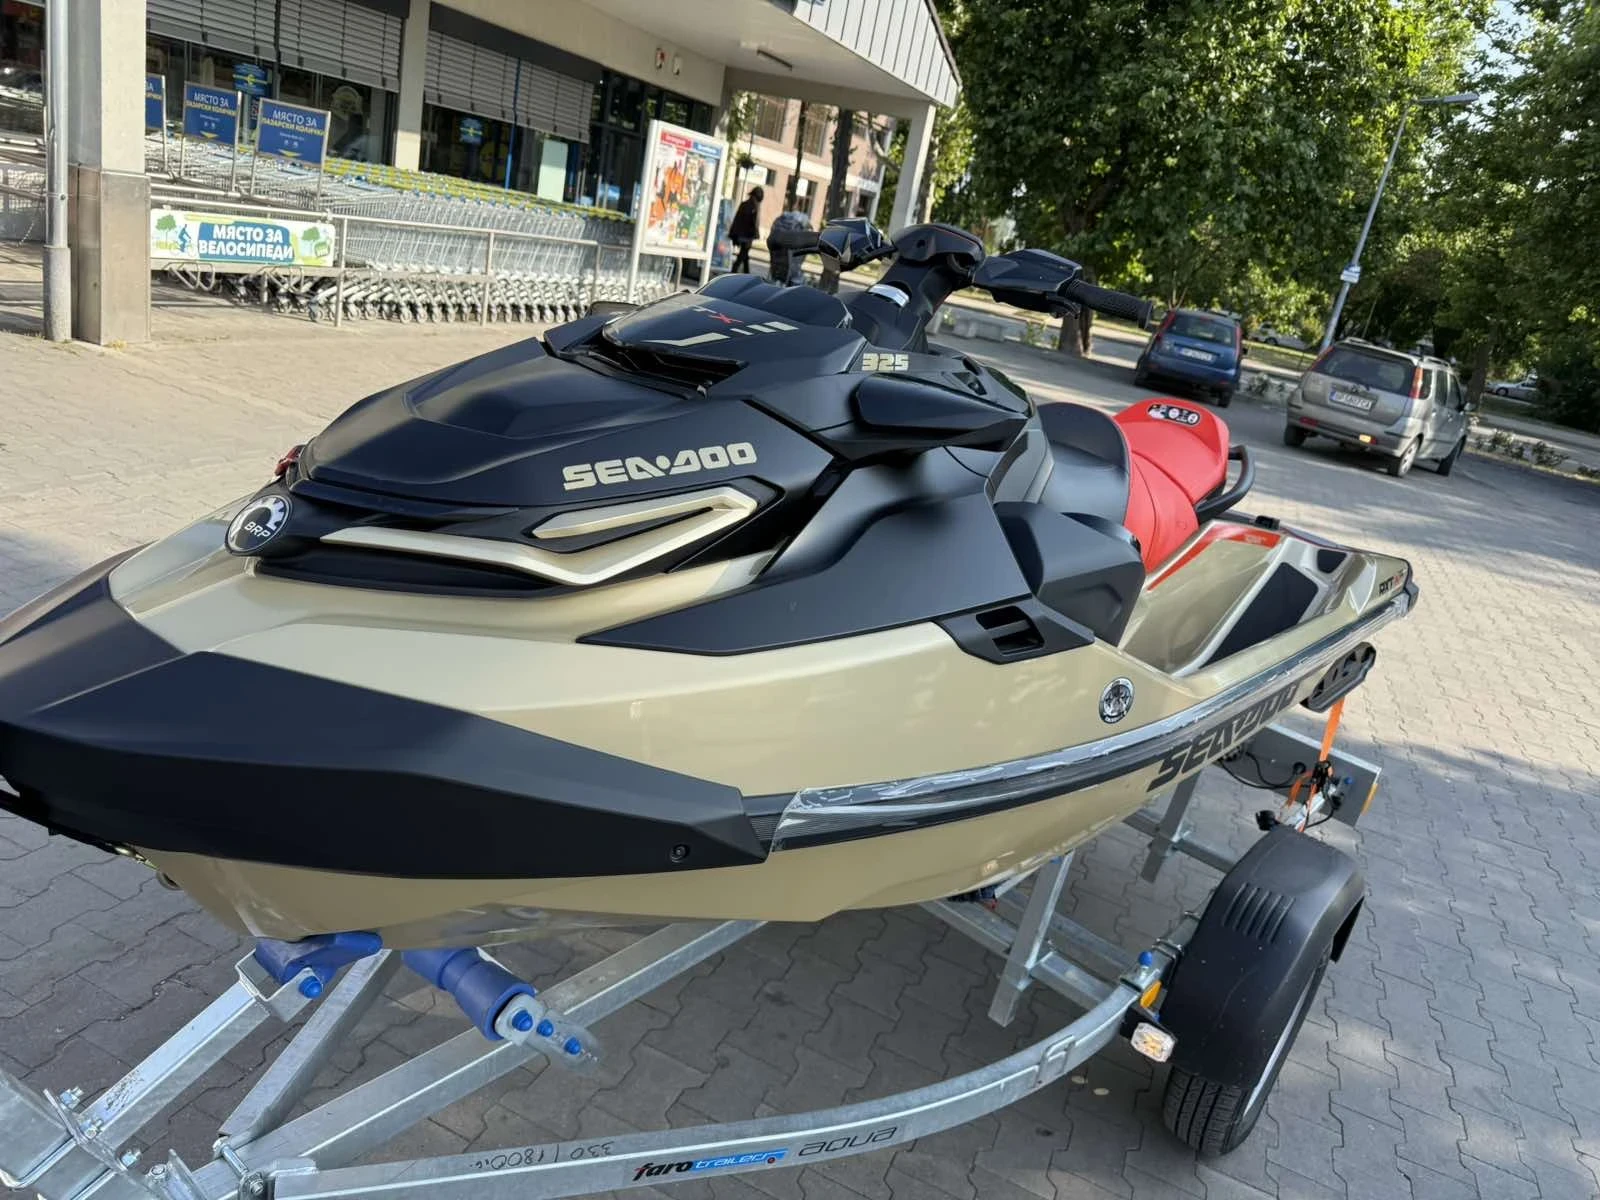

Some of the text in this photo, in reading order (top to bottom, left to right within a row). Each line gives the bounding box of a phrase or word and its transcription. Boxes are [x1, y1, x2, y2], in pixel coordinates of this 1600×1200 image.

[194, 91, 229, 108] МЯСТО ЗА
[272, 109, 304, 125] МЯСТО
[305, 117, 317, 127] ЗА
[212, 224, 283, 243] МЯСТО ЗА
[199, 240, 294, 260] ВЕЛОСИПЕДИ
[861, 353, 909, 371] 325
[244, 521, 271, 537] BRP
[570, 1141, 615, 1160] 330
[632, 1161, 694, 1181] faro
[799, 1126, 898, 1157] aqua
